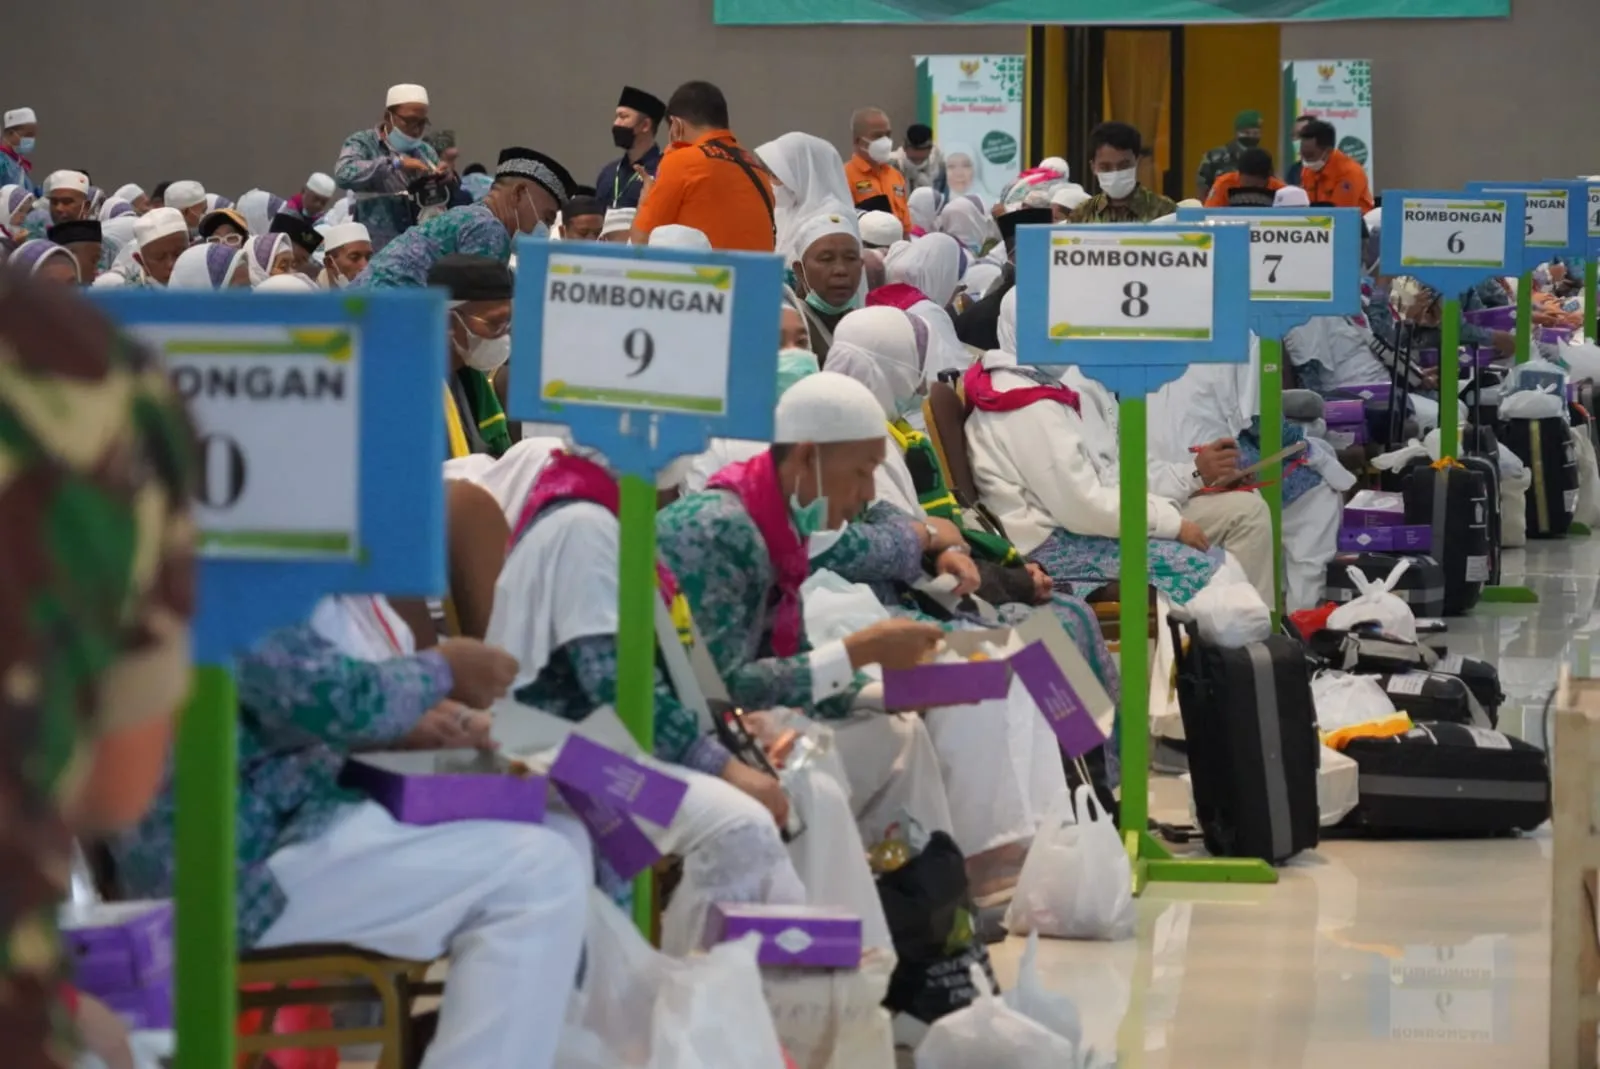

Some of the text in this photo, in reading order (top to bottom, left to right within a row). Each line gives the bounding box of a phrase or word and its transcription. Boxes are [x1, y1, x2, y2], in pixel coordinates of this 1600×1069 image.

[1405, 210, 1502, 223] ROMBONGAN
[1250, 230, 1329, 244] BONGAN
[1446, 230, 1465, 254] 6
[1053, 249, 1208, 268] ROMBONGAN
[1263, 254, 1284, 283] 7
[550, 281, 725, 315] ROMBONGAN
[1121, 280, 1149, 318] 8
[623, 327, 655, 378] 9
[171, 364, 345, 400] ONGAN
[197, 432, 247, 510] 0
